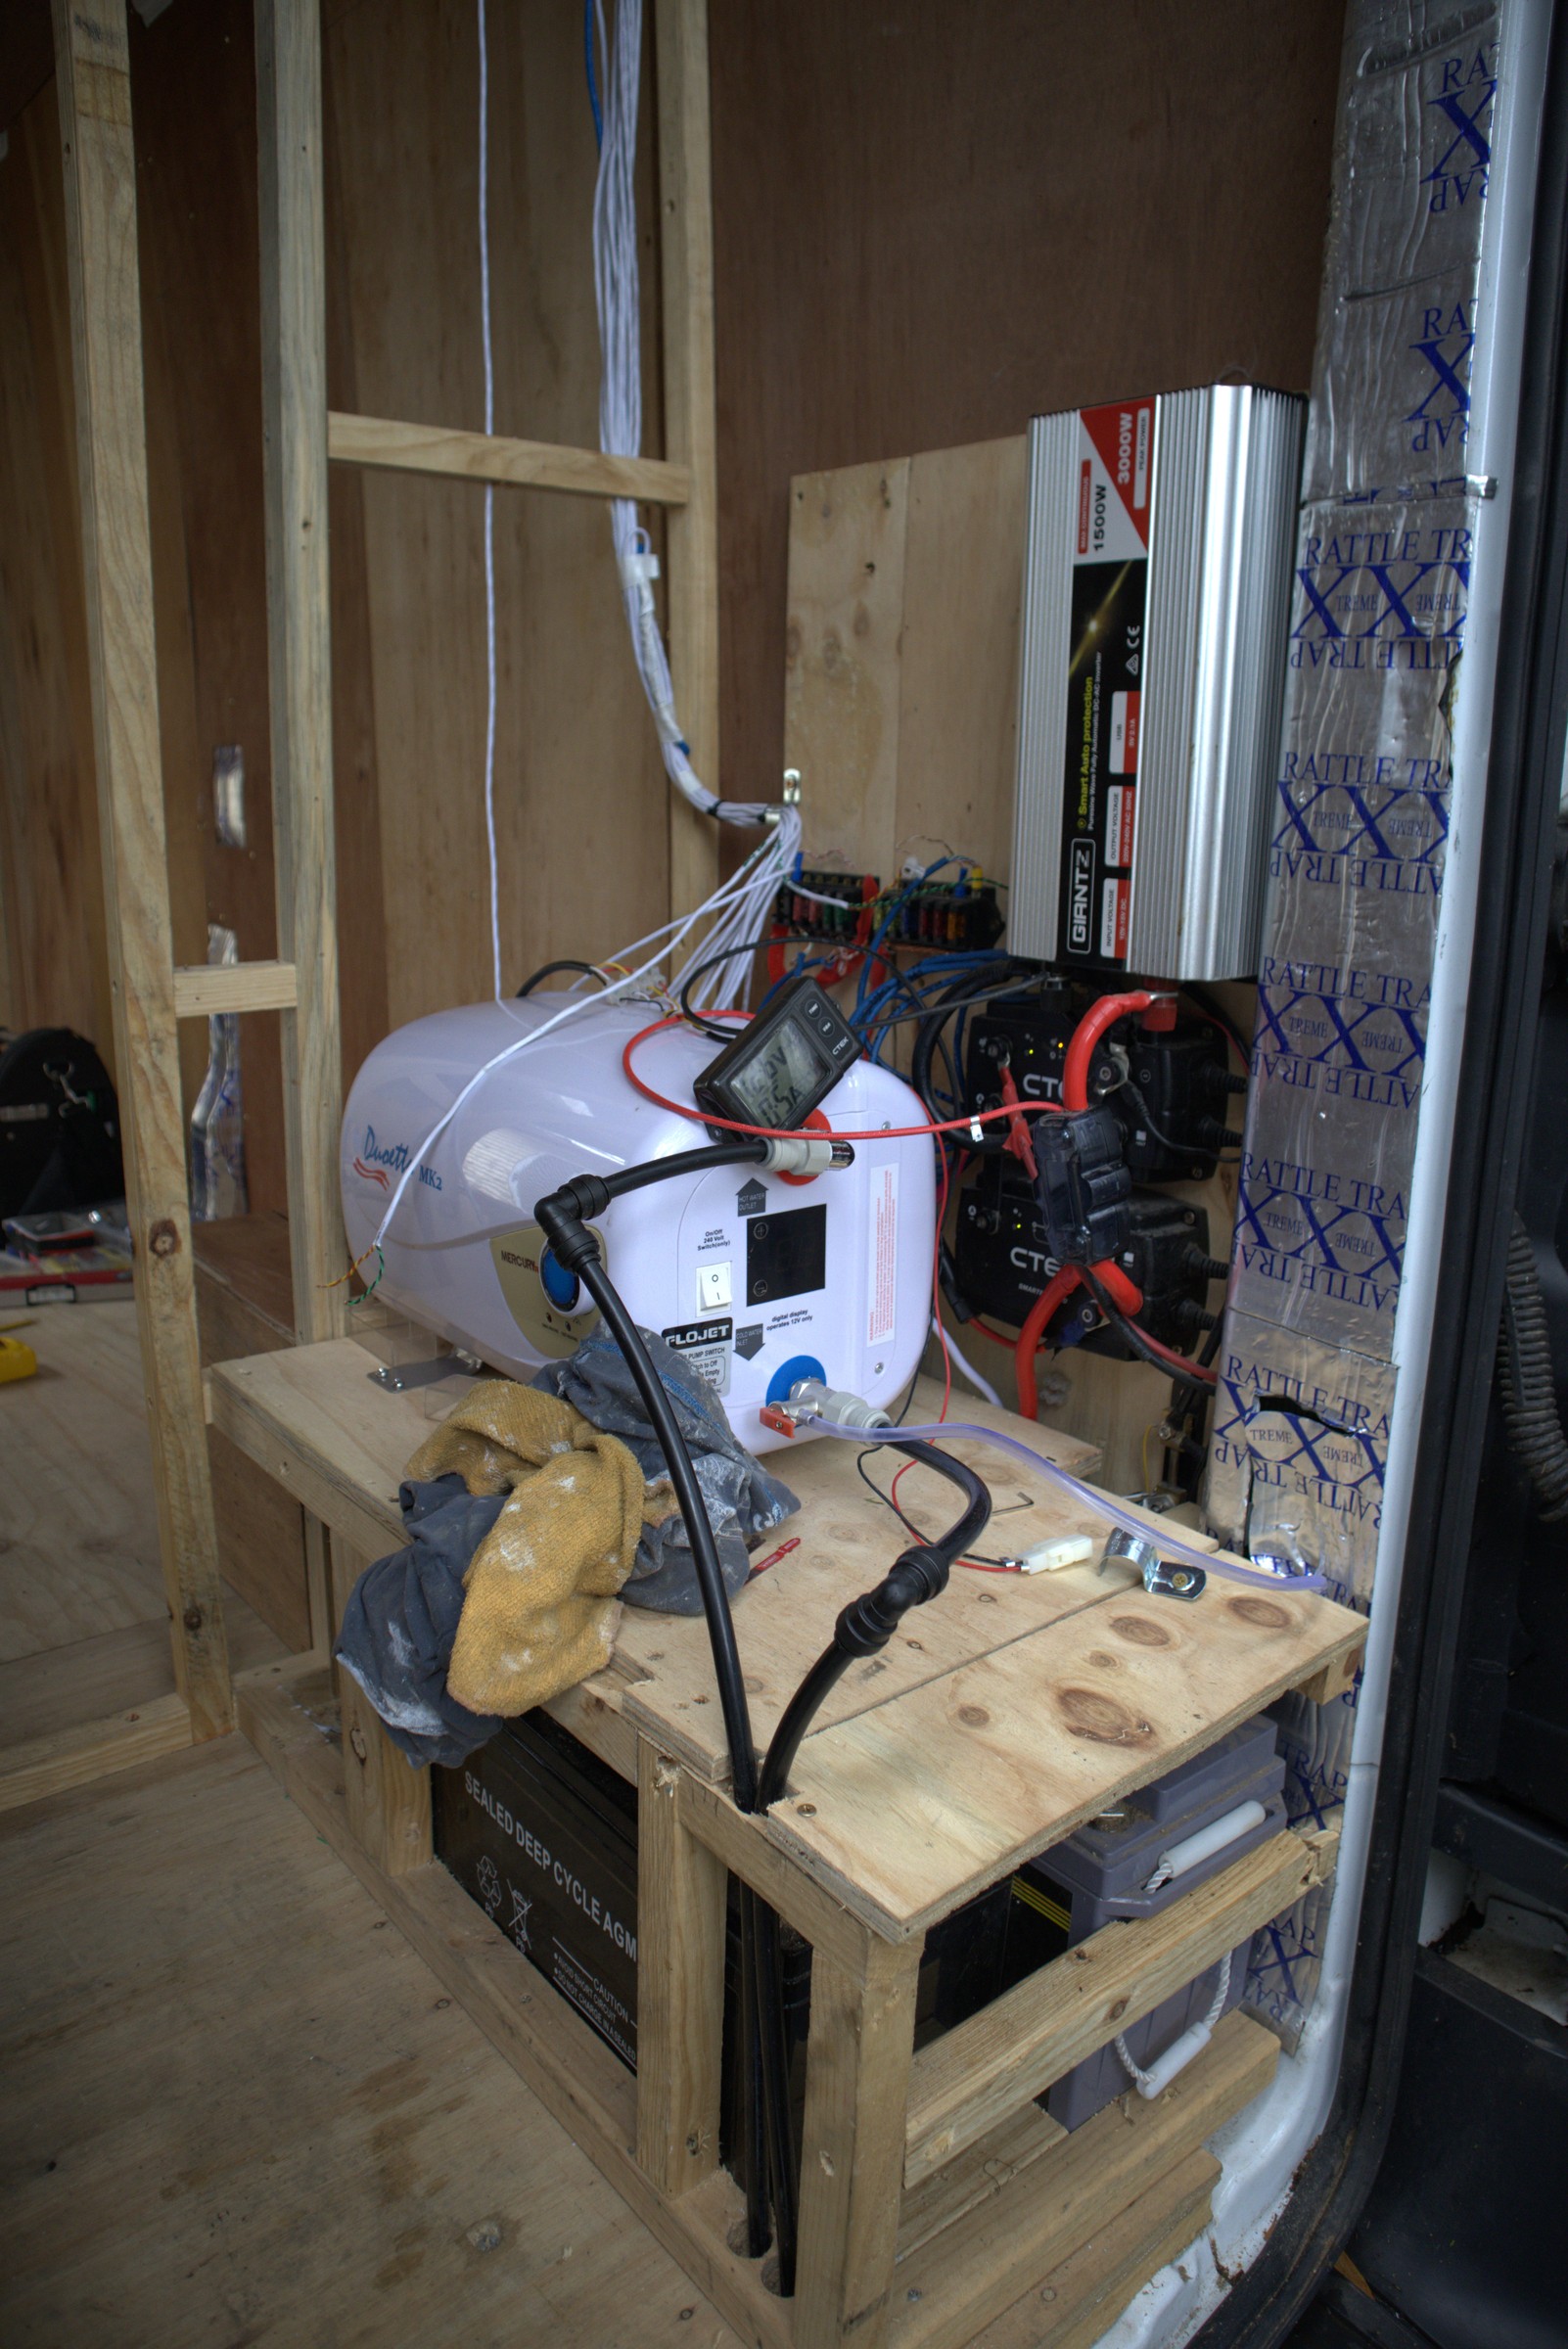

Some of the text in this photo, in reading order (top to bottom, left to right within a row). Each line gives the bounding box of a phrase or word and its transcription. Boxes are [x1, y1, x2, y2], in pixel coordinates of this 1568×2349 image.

[1118, 412, 1133, 484] 3000W
[1093, 484, 1107, 551] 1500W
[1303, 531, 1420, 565] RATTLE
[1335, 593, 1378, 612] TREME
[1291, 639, 1365, 669] TRAP
[1078, 676, 1094, 815] Smart Auto protection
[1091, 712, 1100, 753] Automatic
[1283, 752, 1396, 785] RATTLE
[1111, 792, 1120, 827] VOLTAGE
[1269, 849, 1342, 884] TRAP
[1073, 850, 1089, 943] GIANTZ
[1263, 956, 1366, 1000] RATTLE
[1289, 1016, 1328, 1037] TREME
[1361, 1031, 1404, 1054] TREME
[832, 1036, 850, 1055] CTEK
[419, 1165, 442, 1191] MK2
[1242, 1152, 1341, 1202] RATTLE
[1266, 1212, 1304, 1235] TREME
[1335, 1232, 1375, 1257] TREME
[766, 1321, 789, 1331] operates
[772, 1309, 808, 1323] digital display
[666, 1324, 729, 1348] FLOJET
[705, 1347, 725, 1357] SWITCH
[1226, 1355, 1328, 1413] RATTLE
[1250, 1429, 1293, 1445] TREME
[1323, 1445, 1363, 1467] TREME
[464, 1771, 637, 1962] SEALED DEEP CYCLE AGM
[575, 1973, 593, 1999] SHORT
[593, 1994, 617, 2024] CIRCUIT
[593, 1978, 629, 2024] CAUTION
[567, 1981, 578, 1997] NOT
[578, 1993, 603, 2025] CHARGE
[614, 2030, 636, 2061] SEALED
